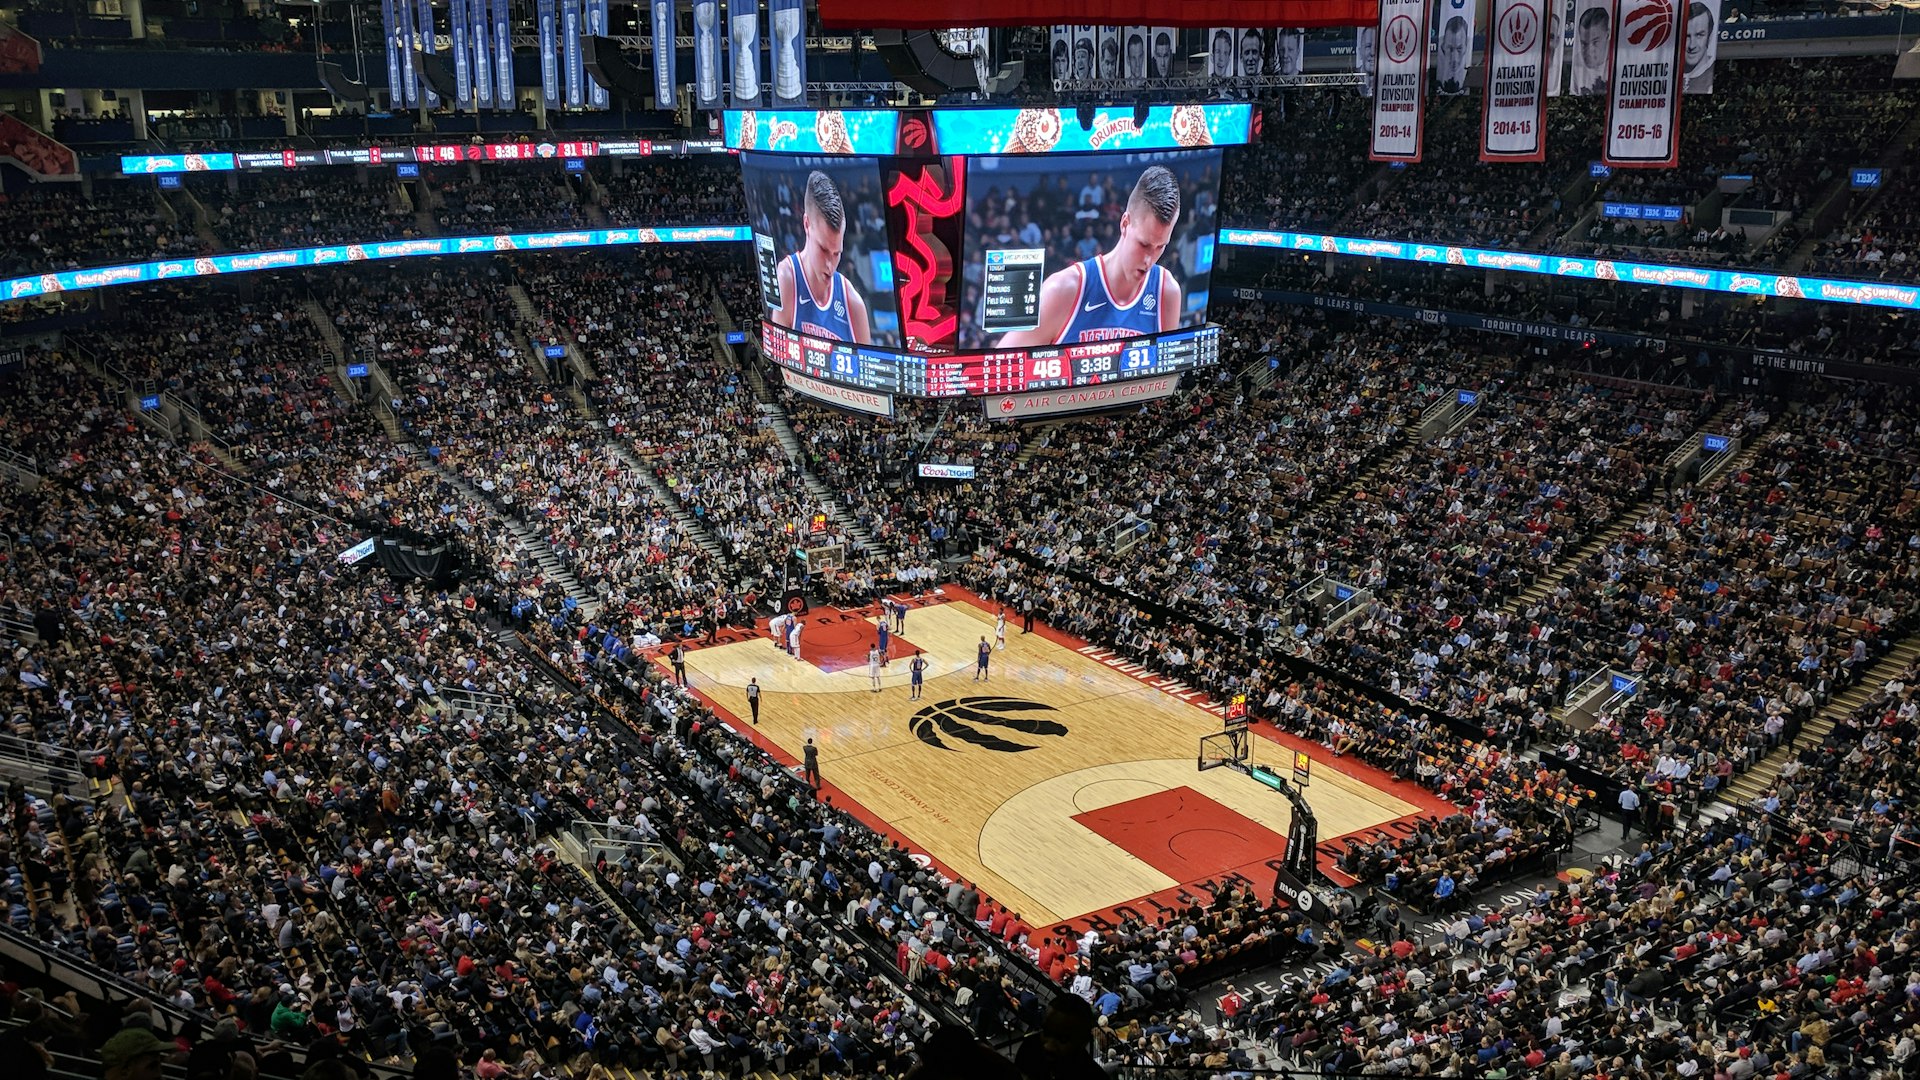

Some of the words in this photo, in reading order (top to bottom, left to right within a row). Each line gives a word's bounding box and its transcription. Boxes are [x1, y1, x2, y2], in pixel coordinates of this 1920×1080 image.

[1496, 65, 1535, 79] ATLANTC
[1622, 62, 1668, 78] ATLANTIC
[1382, 74, 1416, 86] ATLANTIC
[1382, 88, 1414, 101] DIVISION
[1495, 80, 1534, 96] DIVISION
[1620, 80, 1667, 96] DIVISION
[1381, 104, 1414, 112] CHAMPIONS
[1380, 125, 1411, 138] 2013-14
[1494, 120, 1530, 134] 2014-15
[1617, 124, 1662, 139] 2015-16
[440, 146, 454, 160] 46
[495, 146, 518, 158] 3:38
[564, 144, 577, 156] 31
[161, 177, 177, 185] IBM
[1856, 174, 1877, 183] IBM
[1606, 206, 1620, 214] IBM
[1625, 206, 1639, 216] IBM
[1645, 208, 1659, 217] IBM
[1664, 209, 1679, 218] IBM
[1029, 272, 1034, 280] 4
[1028, 283, 1033, 291] 2
[1025, 306, 1034, 314] 15
[1314, 296, 1324, 305] GO
[1327, 298, 1350, 310] LEAFS
[1354, 303, 1364, 311] GO
[1424, 312, 1437, 321] 107
[1482, 319, 1522, 332] TORONTO
[1527, 325, 1557, 337] MAPLE
[1564, 330, 1596, 342] LEAFS
[788, 342, 800, 360] 46
[1086, 343, 1121, 355] TISSOT
[808, 350, 825, 367] 3:38
[836, 354, 853, 374] 31
[1080, 356, 1111, 373] 3:38
[1128, 349, 1150, 368] 31
[1753, 355, 1764, 365] WE
[1768, 357, 1786, 368] THE
[1789, 360, 1825, 373] NORTH
[1033, 360, 1061, 378] 46
[794, 375, 805, 386] AIR
[806, 380, 838, 397] CANADA
[841, 390, 880, 406] CENTRE
[1024, 396, 1049, 408] AIR
[1057, 389, 1115, 405] CANADA
[1121, 380, 1168, 396] CENTRE
[144, 399, 156, 407] IBM
[1461, 394, 1474, 403] IBM
[1708, 438, 1724, 448] IBM
[923, 466, 948, 476] Coors
[948, 468, 973, 477] LIGHT
[812, 522, 825, 531] 24
[1338, 590, 1351, 598] IBM
[1230, 704, 1244, 717] 24
[868, 768, 900, 790] CENTRE
[900, 789, 935, 813] CANADA
[1279, 882, 1297, 899] BMO
